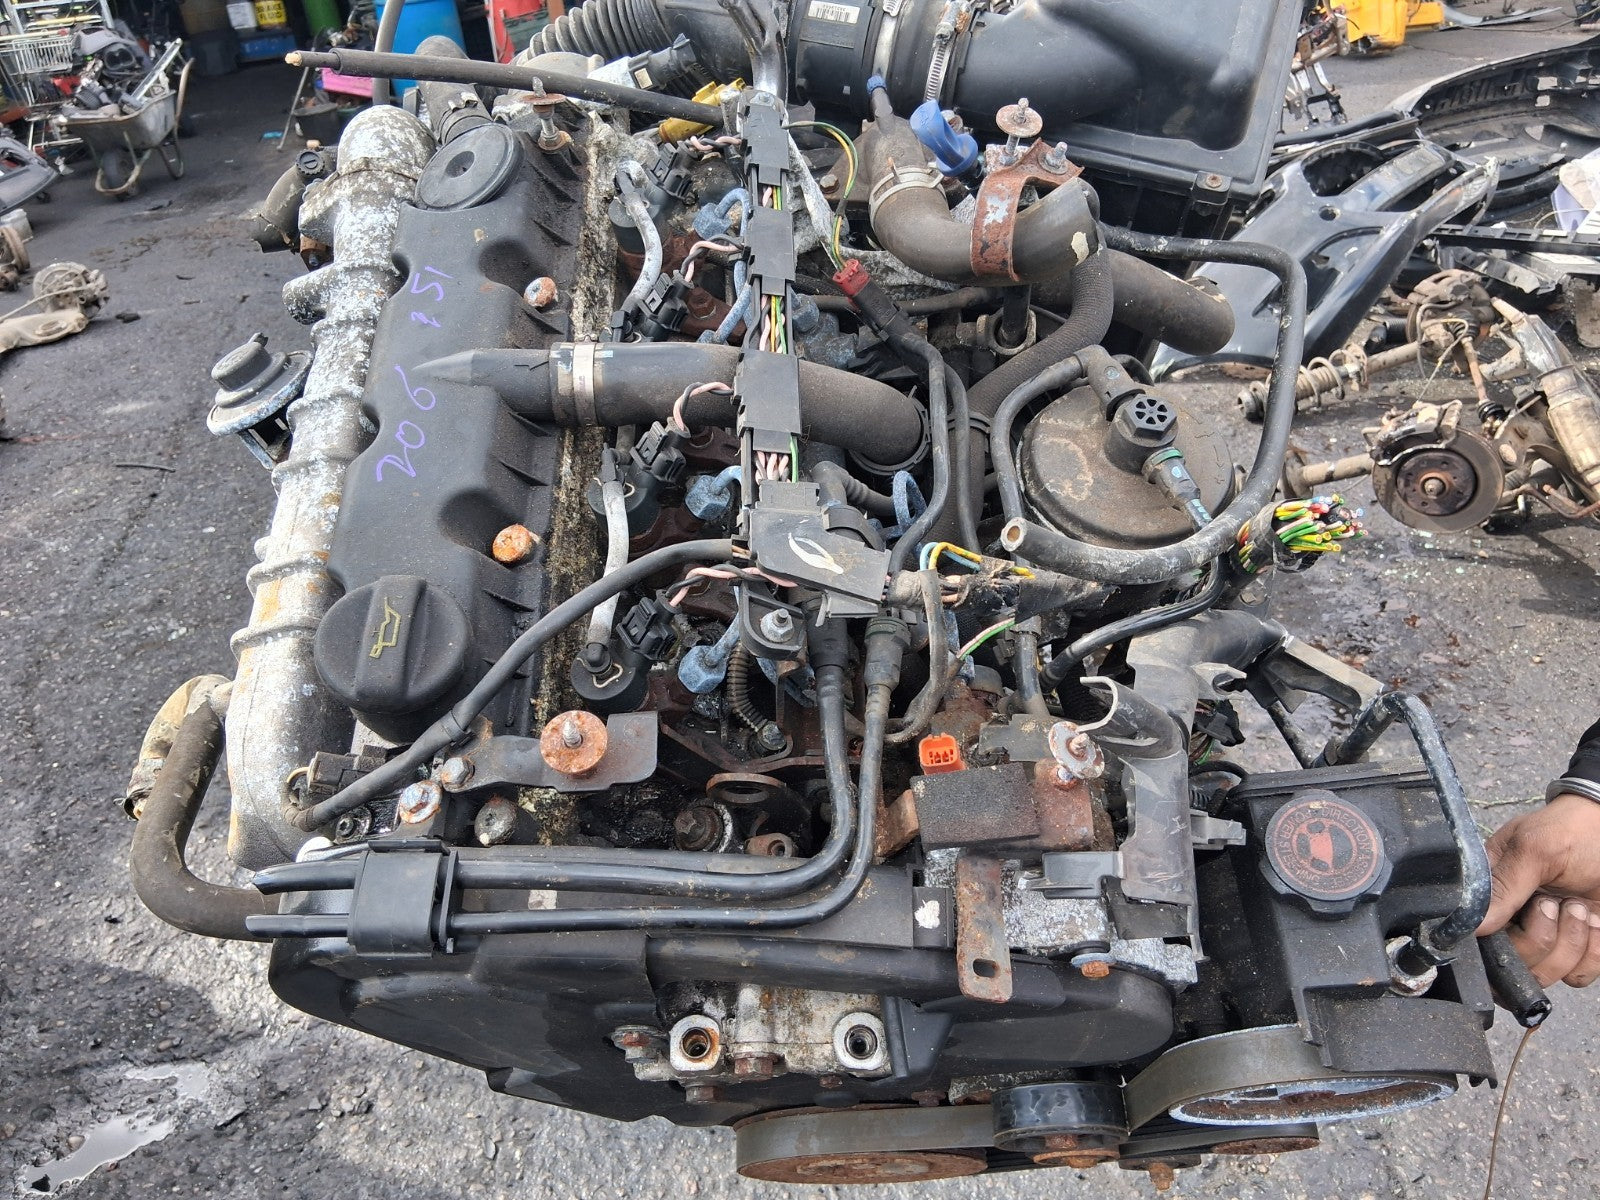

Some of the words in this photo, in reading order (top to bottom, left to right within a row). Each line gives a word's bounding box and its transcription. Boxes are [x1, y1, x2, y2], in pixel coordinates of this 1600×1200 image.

[376, 364, 437, 482] 206
[1281, 811, 1313, 840] POWER
[1321, 807, 1372, 851] DIRECTION
